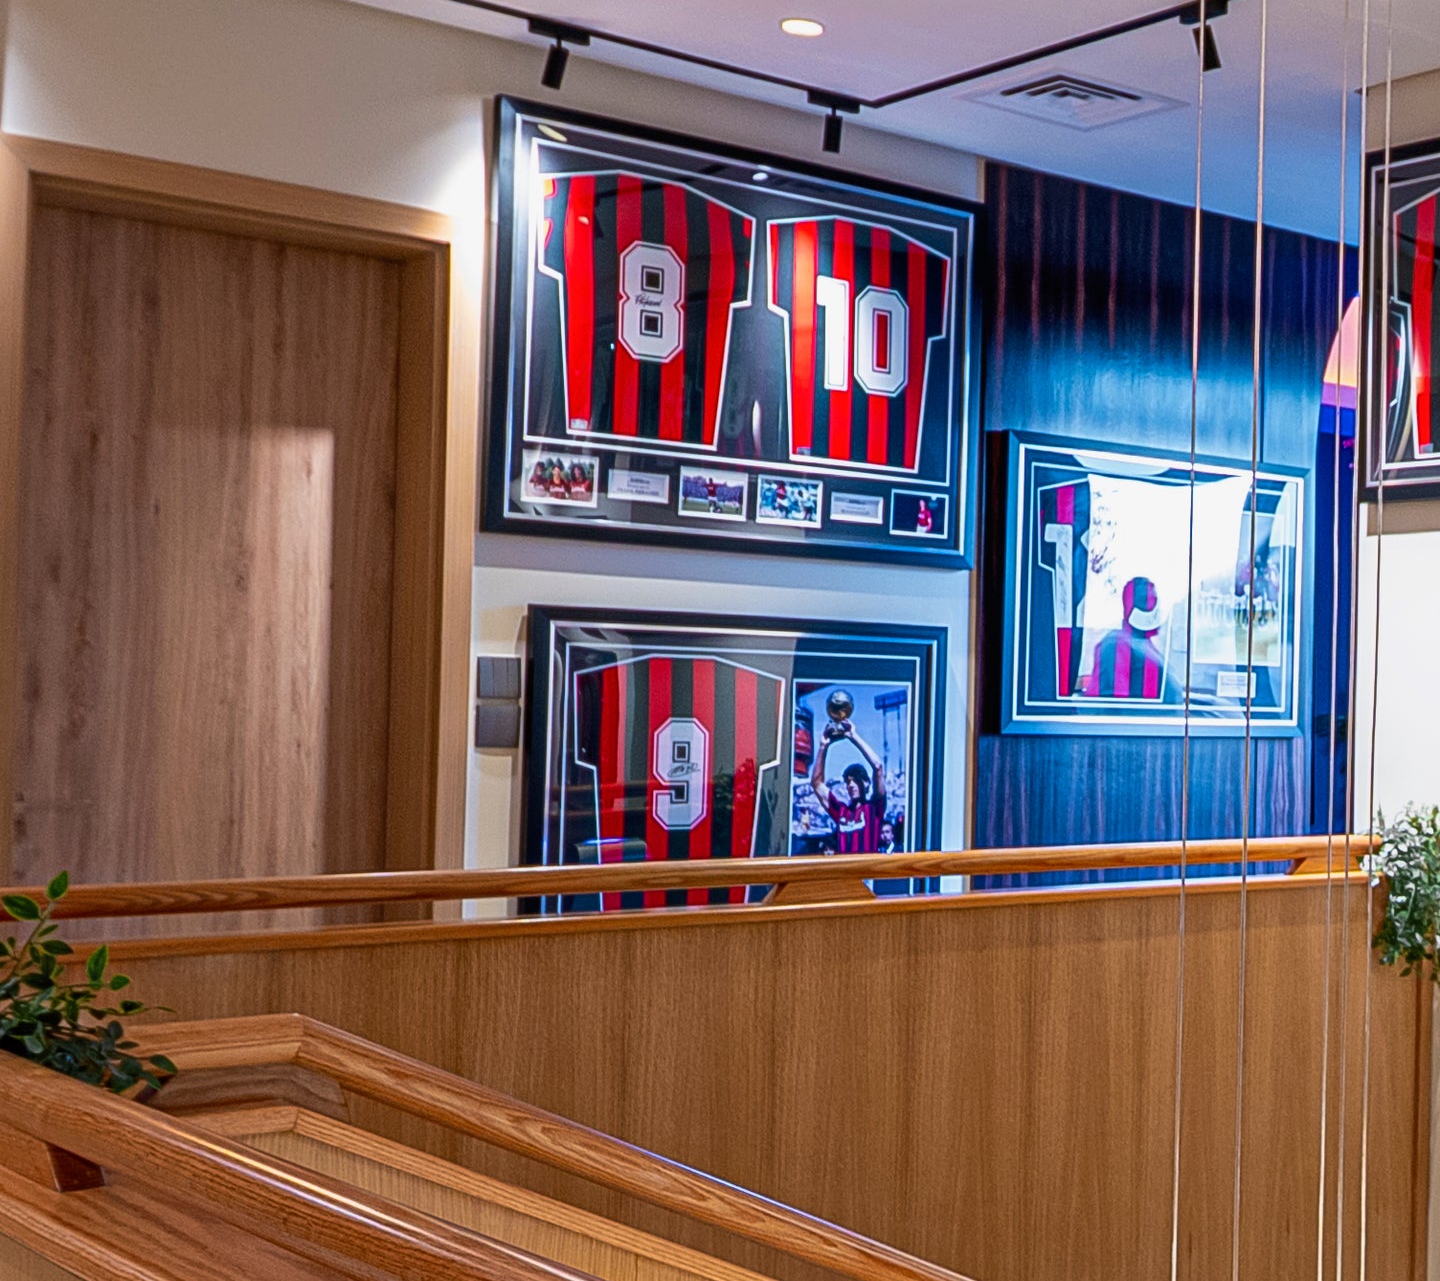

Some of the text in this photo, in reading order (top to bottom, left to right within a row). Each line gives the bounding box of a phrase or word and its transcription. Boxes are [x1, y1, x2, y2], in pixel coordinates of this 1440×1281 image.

[618, 240, 685, 363] 8
[816, 275, 909, 398] 10
[652, 717, 710, 830] 9
